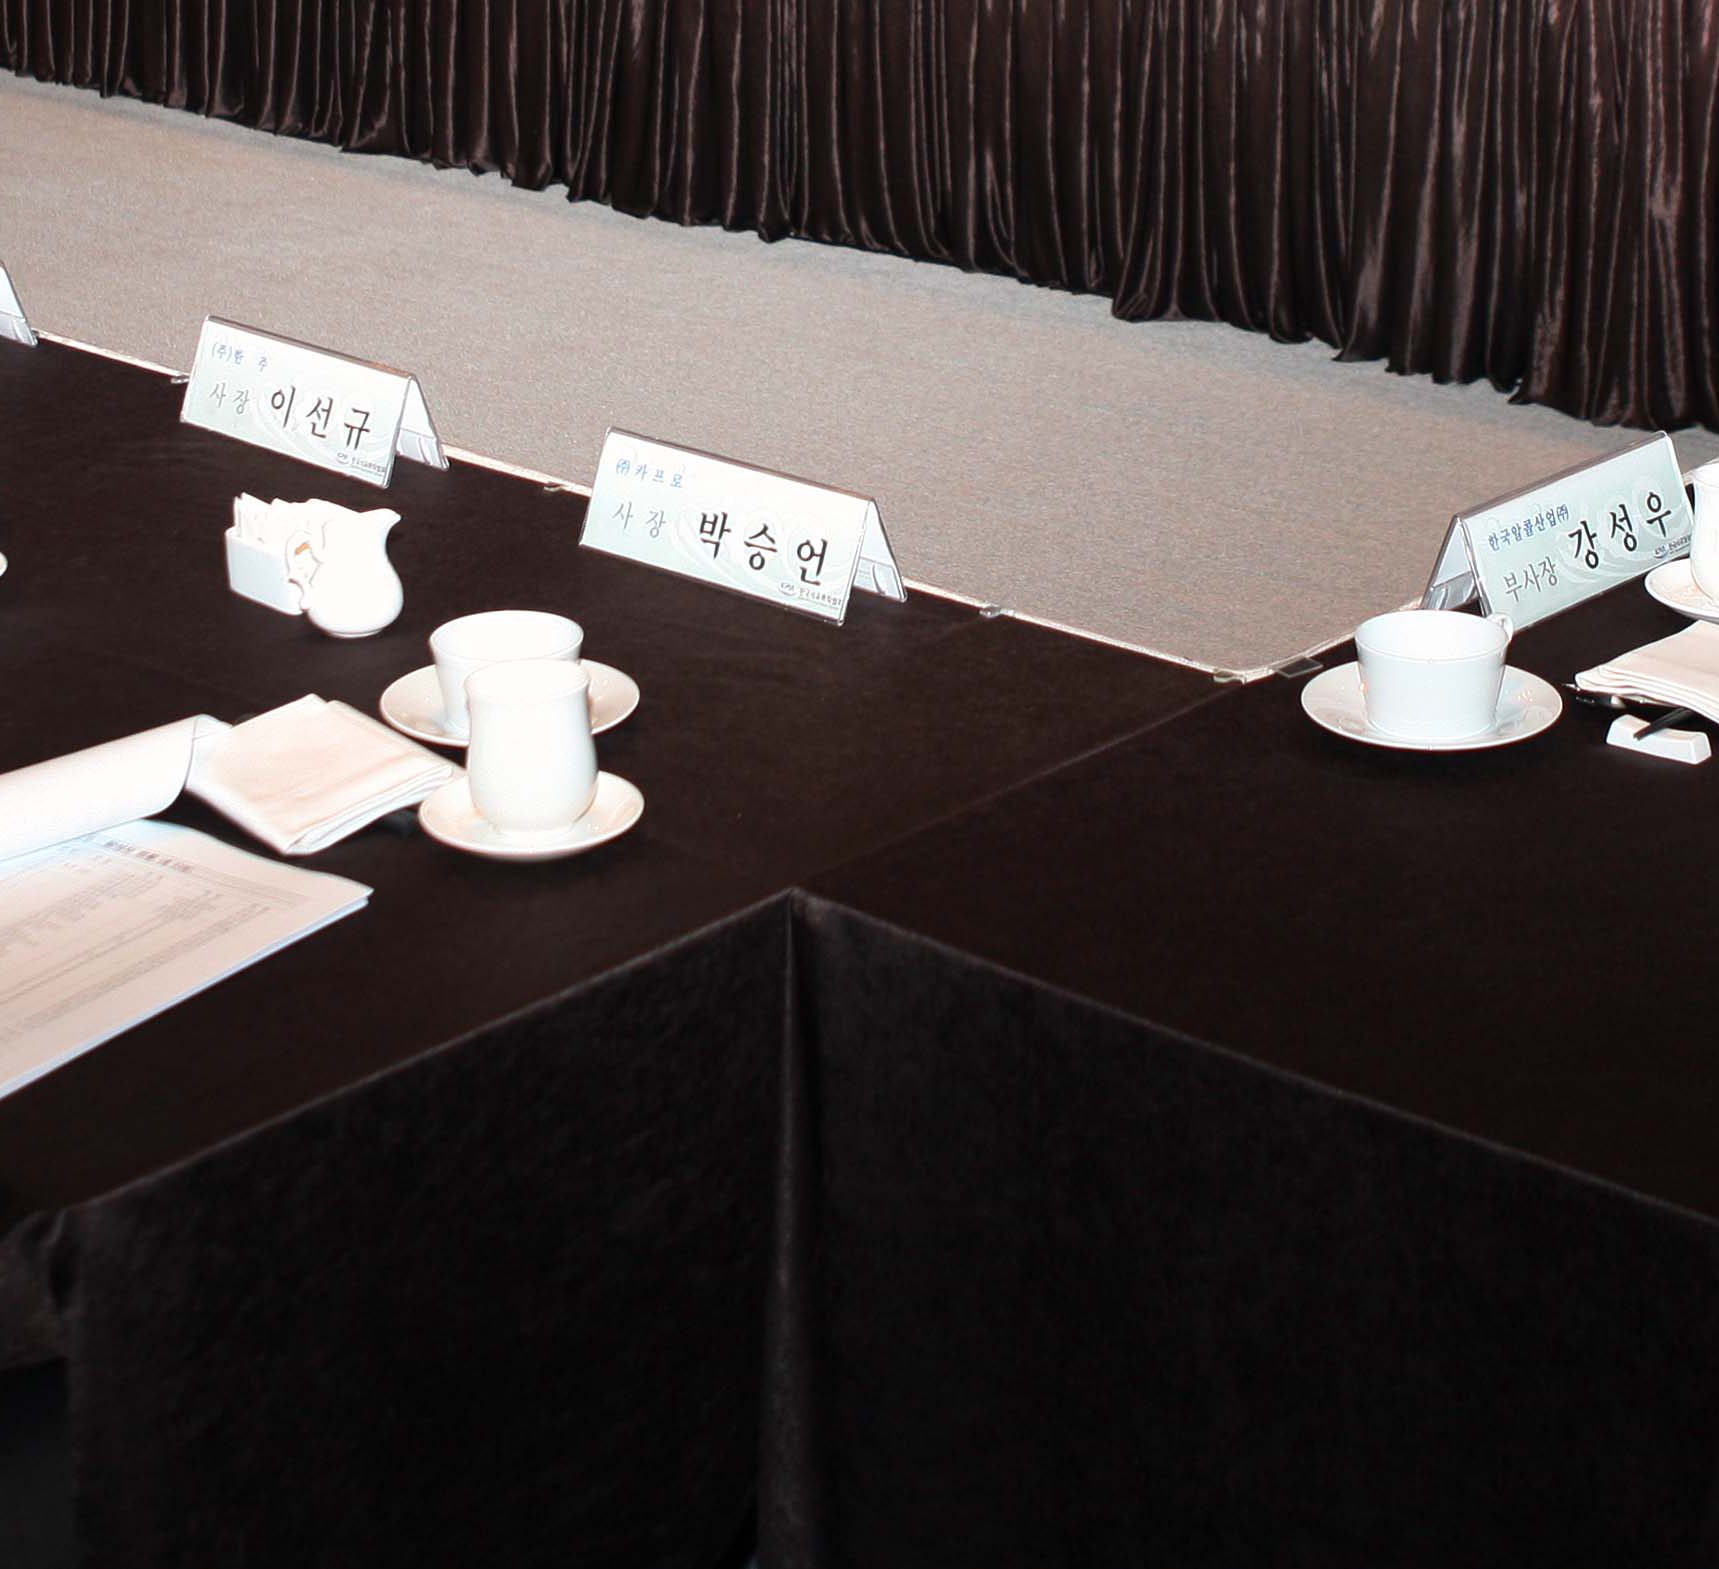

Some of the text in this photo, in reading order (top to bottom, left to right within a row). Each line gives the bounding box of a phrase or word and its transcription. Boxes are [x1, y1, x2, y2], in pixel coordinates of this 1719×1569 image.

[209, 382, 371, 451] 사장 이선규
[611, 500, 829, 587] 사장 박승언
[1501, 555, 1559, 603] 부사장
[1567, 490, 1673, 570] 강성우
